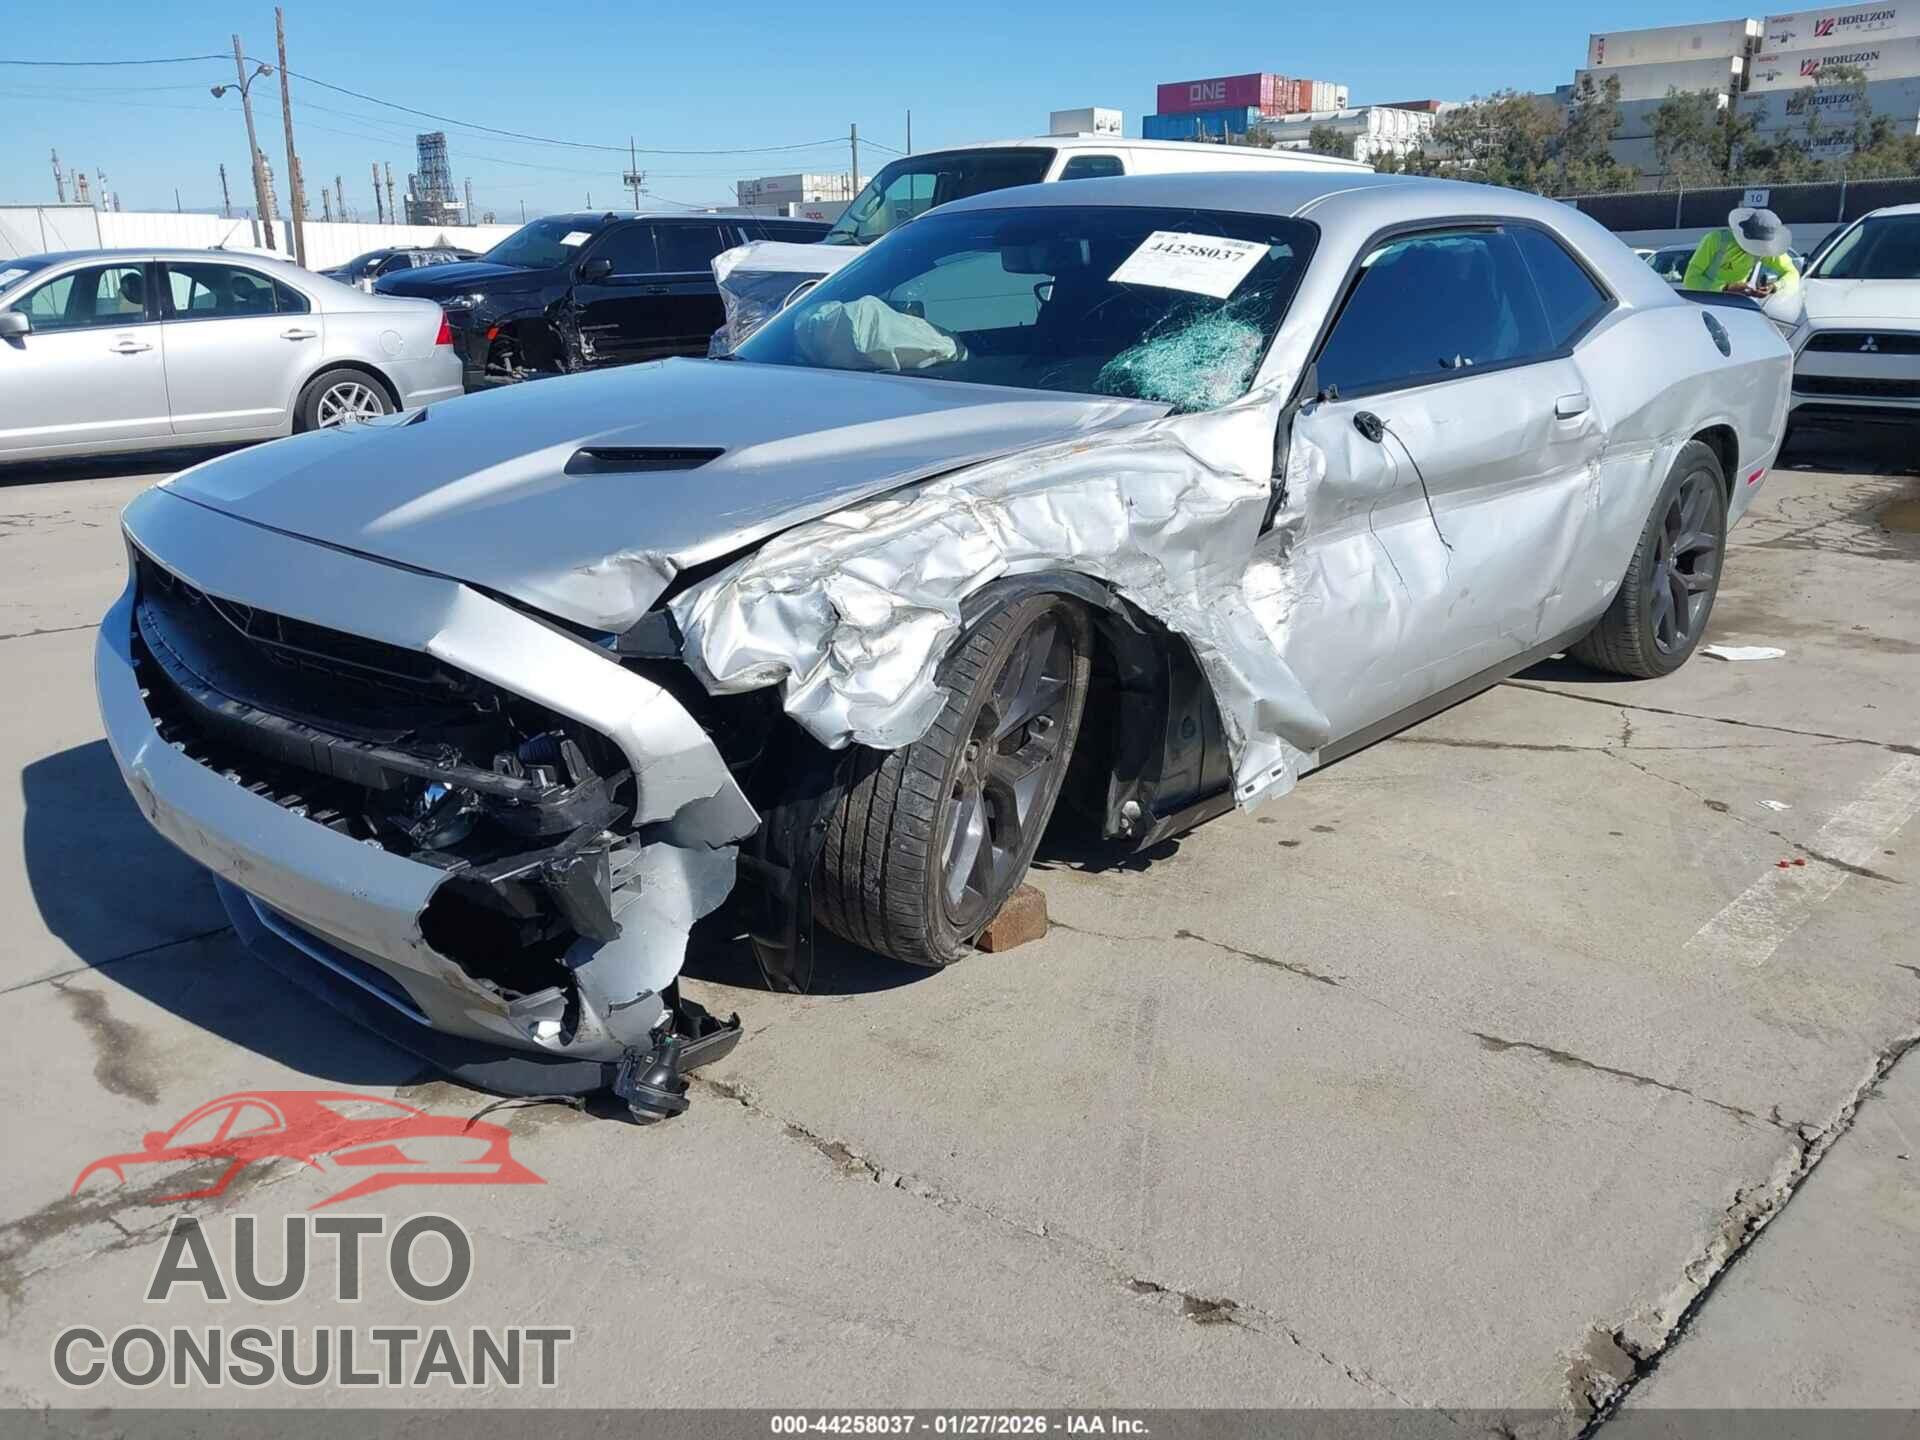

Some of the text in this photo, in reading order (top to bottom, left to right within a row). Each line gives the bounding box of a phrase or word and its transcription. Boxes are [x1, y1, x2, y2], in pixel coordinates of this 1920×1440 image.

[1837, 9, 1895, 25] HORIZON
[1822, 51, 1880, 65] HORIZON
[1190, 82, 1226, 101] ONE
[1751, 194, 1763, 202] 10
[1150, 242, 1245, 263] 44258037
